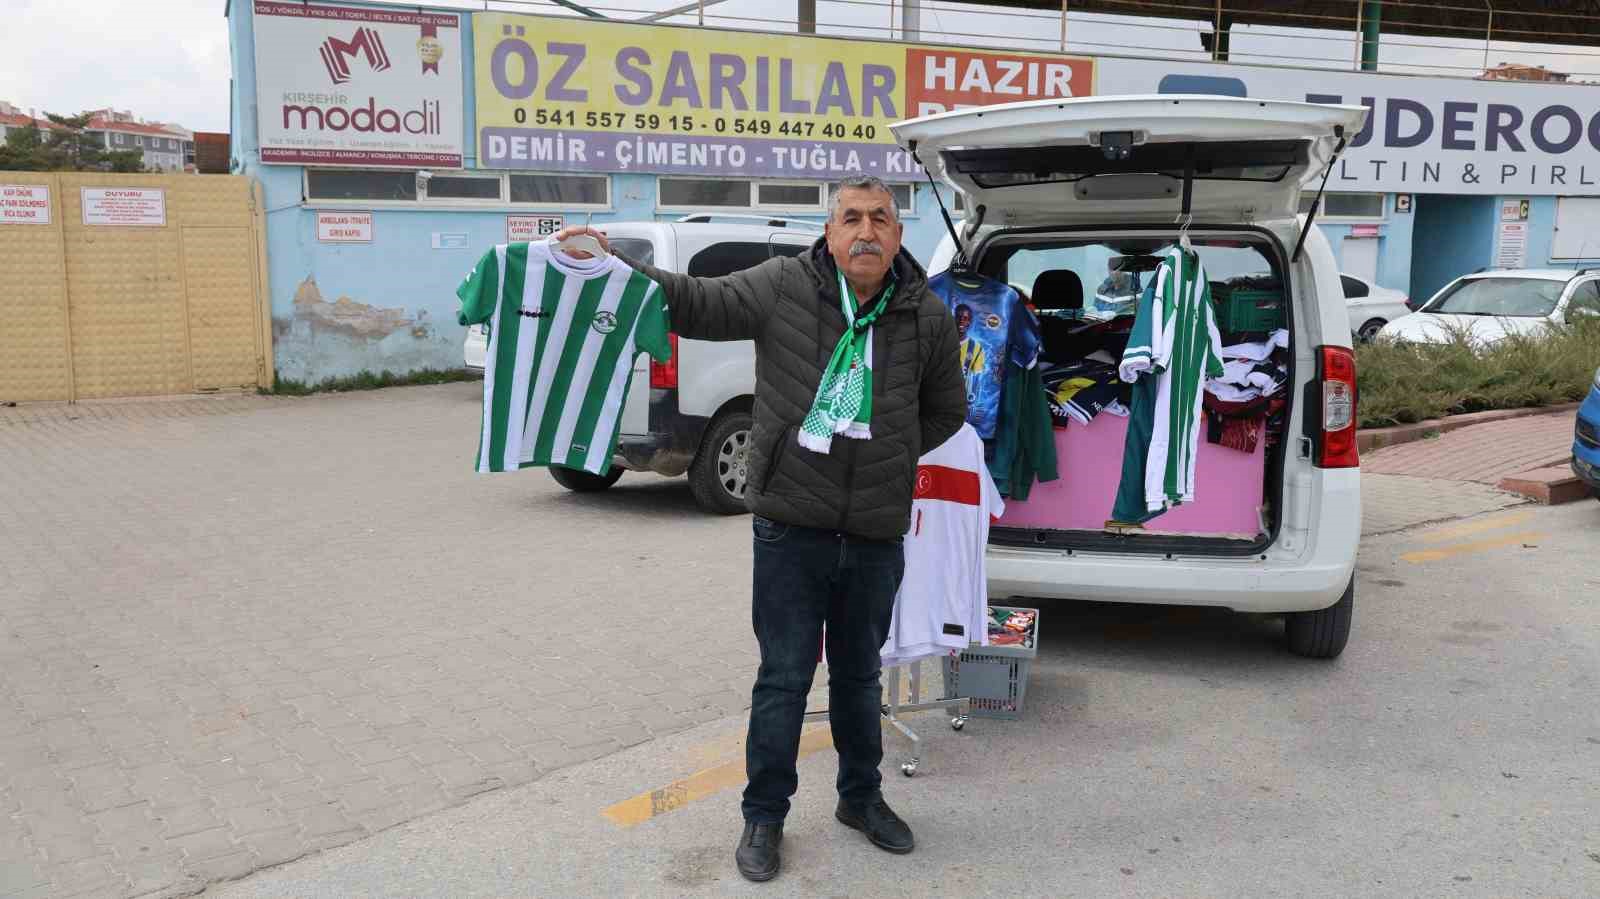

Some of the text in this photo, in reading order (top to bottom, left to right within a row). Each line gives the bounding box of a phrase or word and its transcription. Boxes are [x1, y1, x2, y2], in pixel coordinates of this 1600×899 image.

[491, 24, 898, 118] ÖZ SARILAR
[925, 56, 1073, 97] HAZIR
[514, 108, 526, 123] 0
[536, 109, 575, 126] 541
[586, 112, 626, 128] 557
[635, 114, 660, 129] 59
[670, 115, 693, 131] 15
[715, 118, 726, 133] 0
[735, 118, 771, 134] 549
[779, 120, 815, 136] 447
[823, 122, 845, 138] 40
[853, 124, 876, 140] 40
[488, 132, 587, 162] DEMİR
[615, 137, 746, 168] ÇİMENTO
[772, 144, 861, 172] TUĞLA
[1320, 159, 1594, 185] LTIN & PIRL
